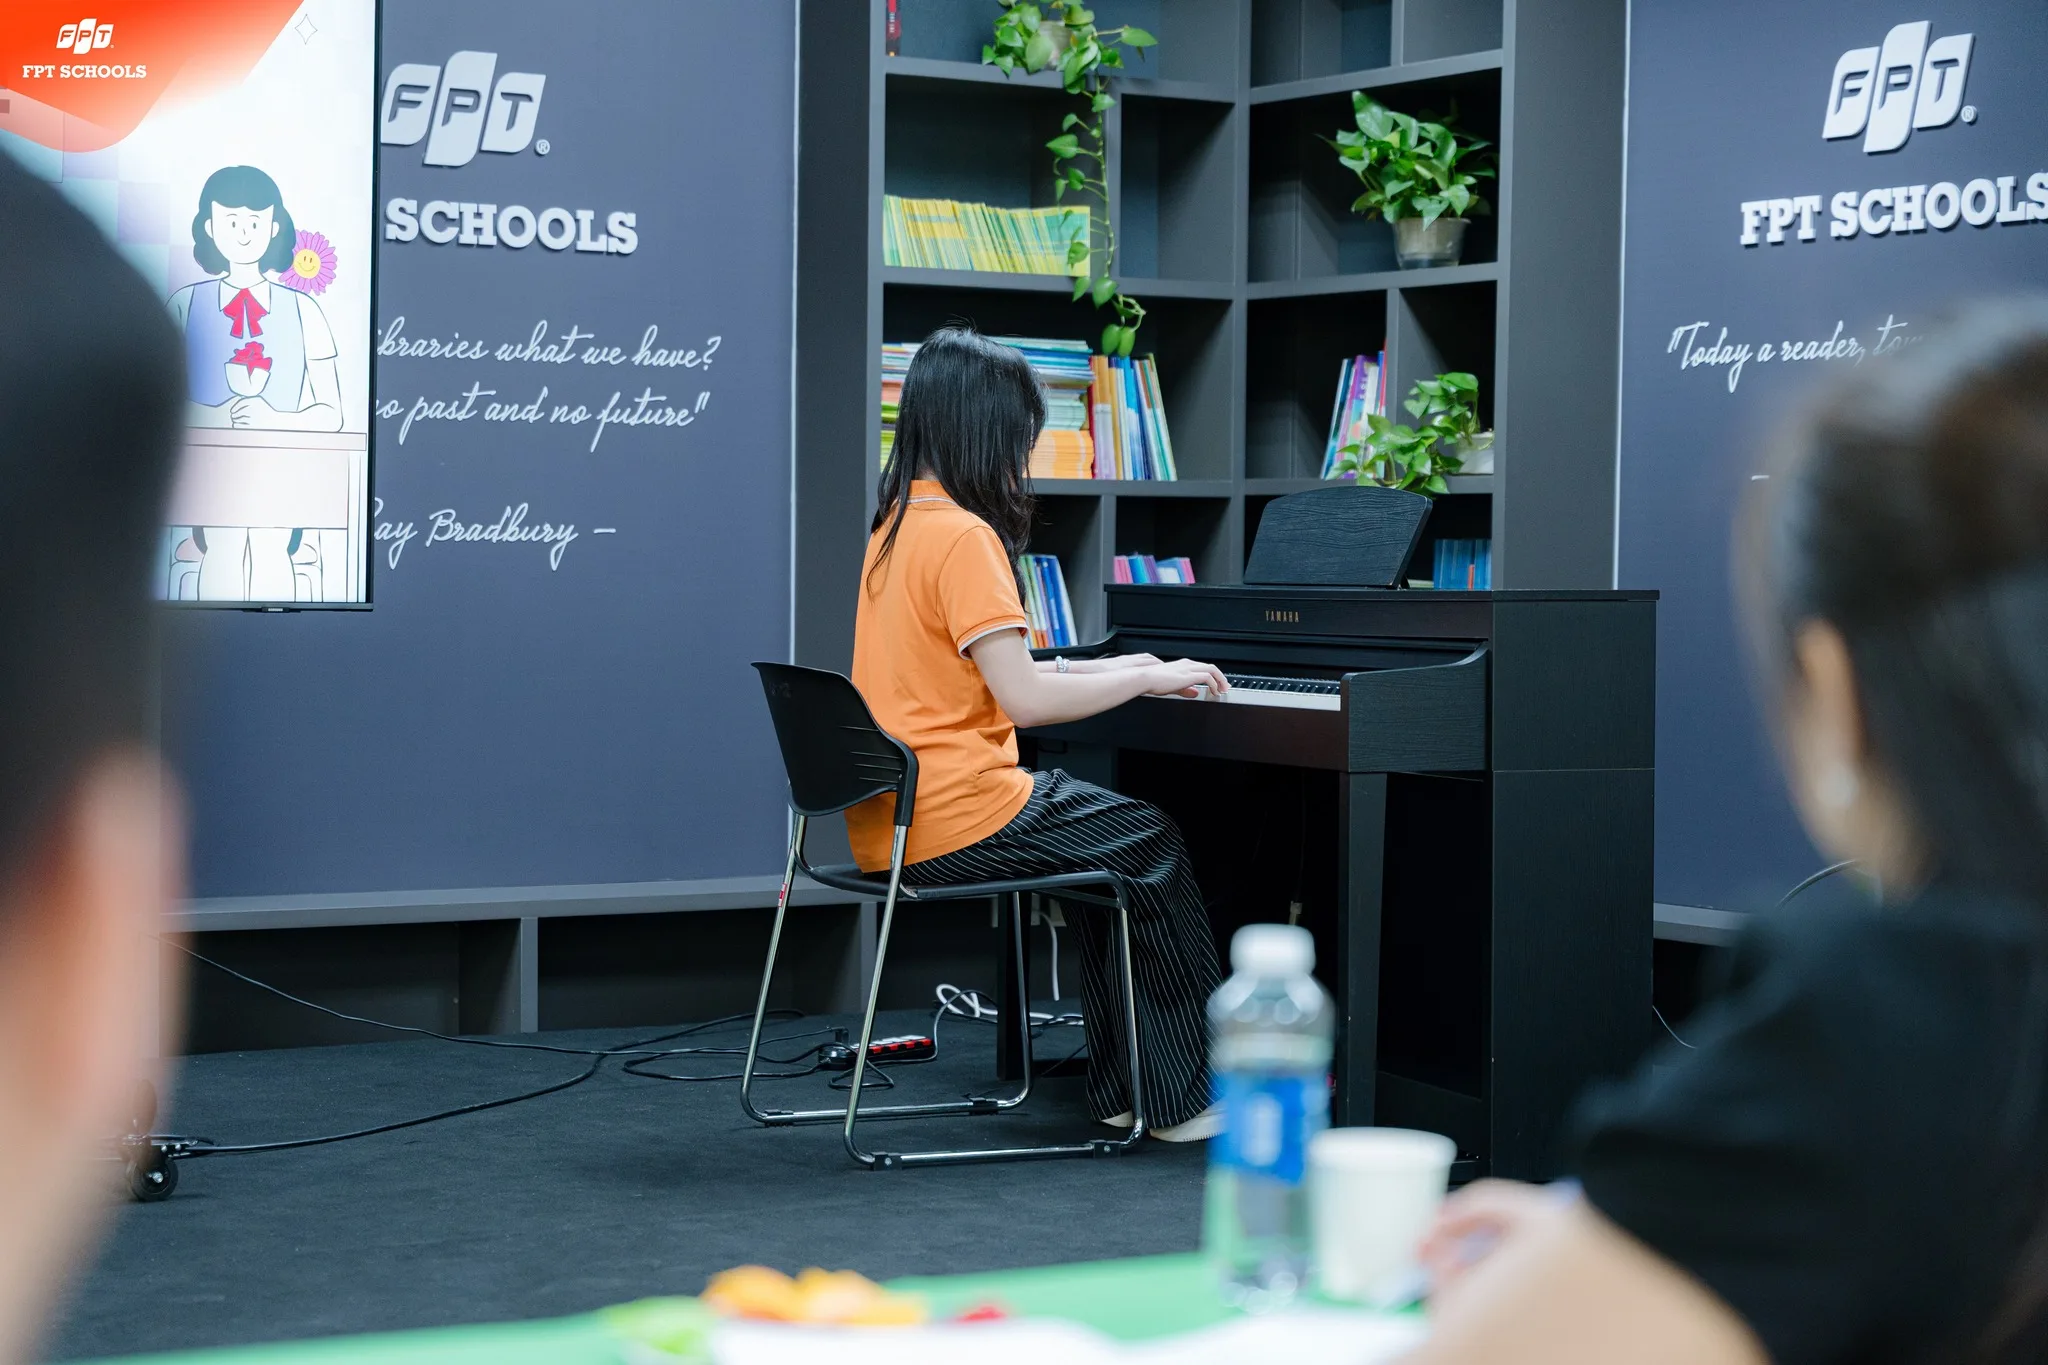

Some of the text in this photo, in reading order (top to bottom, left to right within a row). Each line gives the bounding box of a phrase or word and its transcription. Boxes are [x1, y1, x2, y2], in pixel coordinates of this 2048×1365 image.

[381, 51, 547, 167] FPT
[1822, 20, 1973, 153] FPT
[385, 198, 639, 254] SCHOOLS
[1740, 172, 2048, 247] FPT SCHOOLS
[495, 320, 594, 364] what
[581, 346, 627, 366] we
[632, 325, 721, 370] have?
[1756, 342, 1776, 363] a
[1780, 320, 1867, 368] reader,
[399, 381, 496, 445] past
[484, 386, 548, 423] and
[550, 404, 592, 424] no
[426, 503, 578, 571] Bradbury
[1265, 610, 1300, 623] YAMAHA
